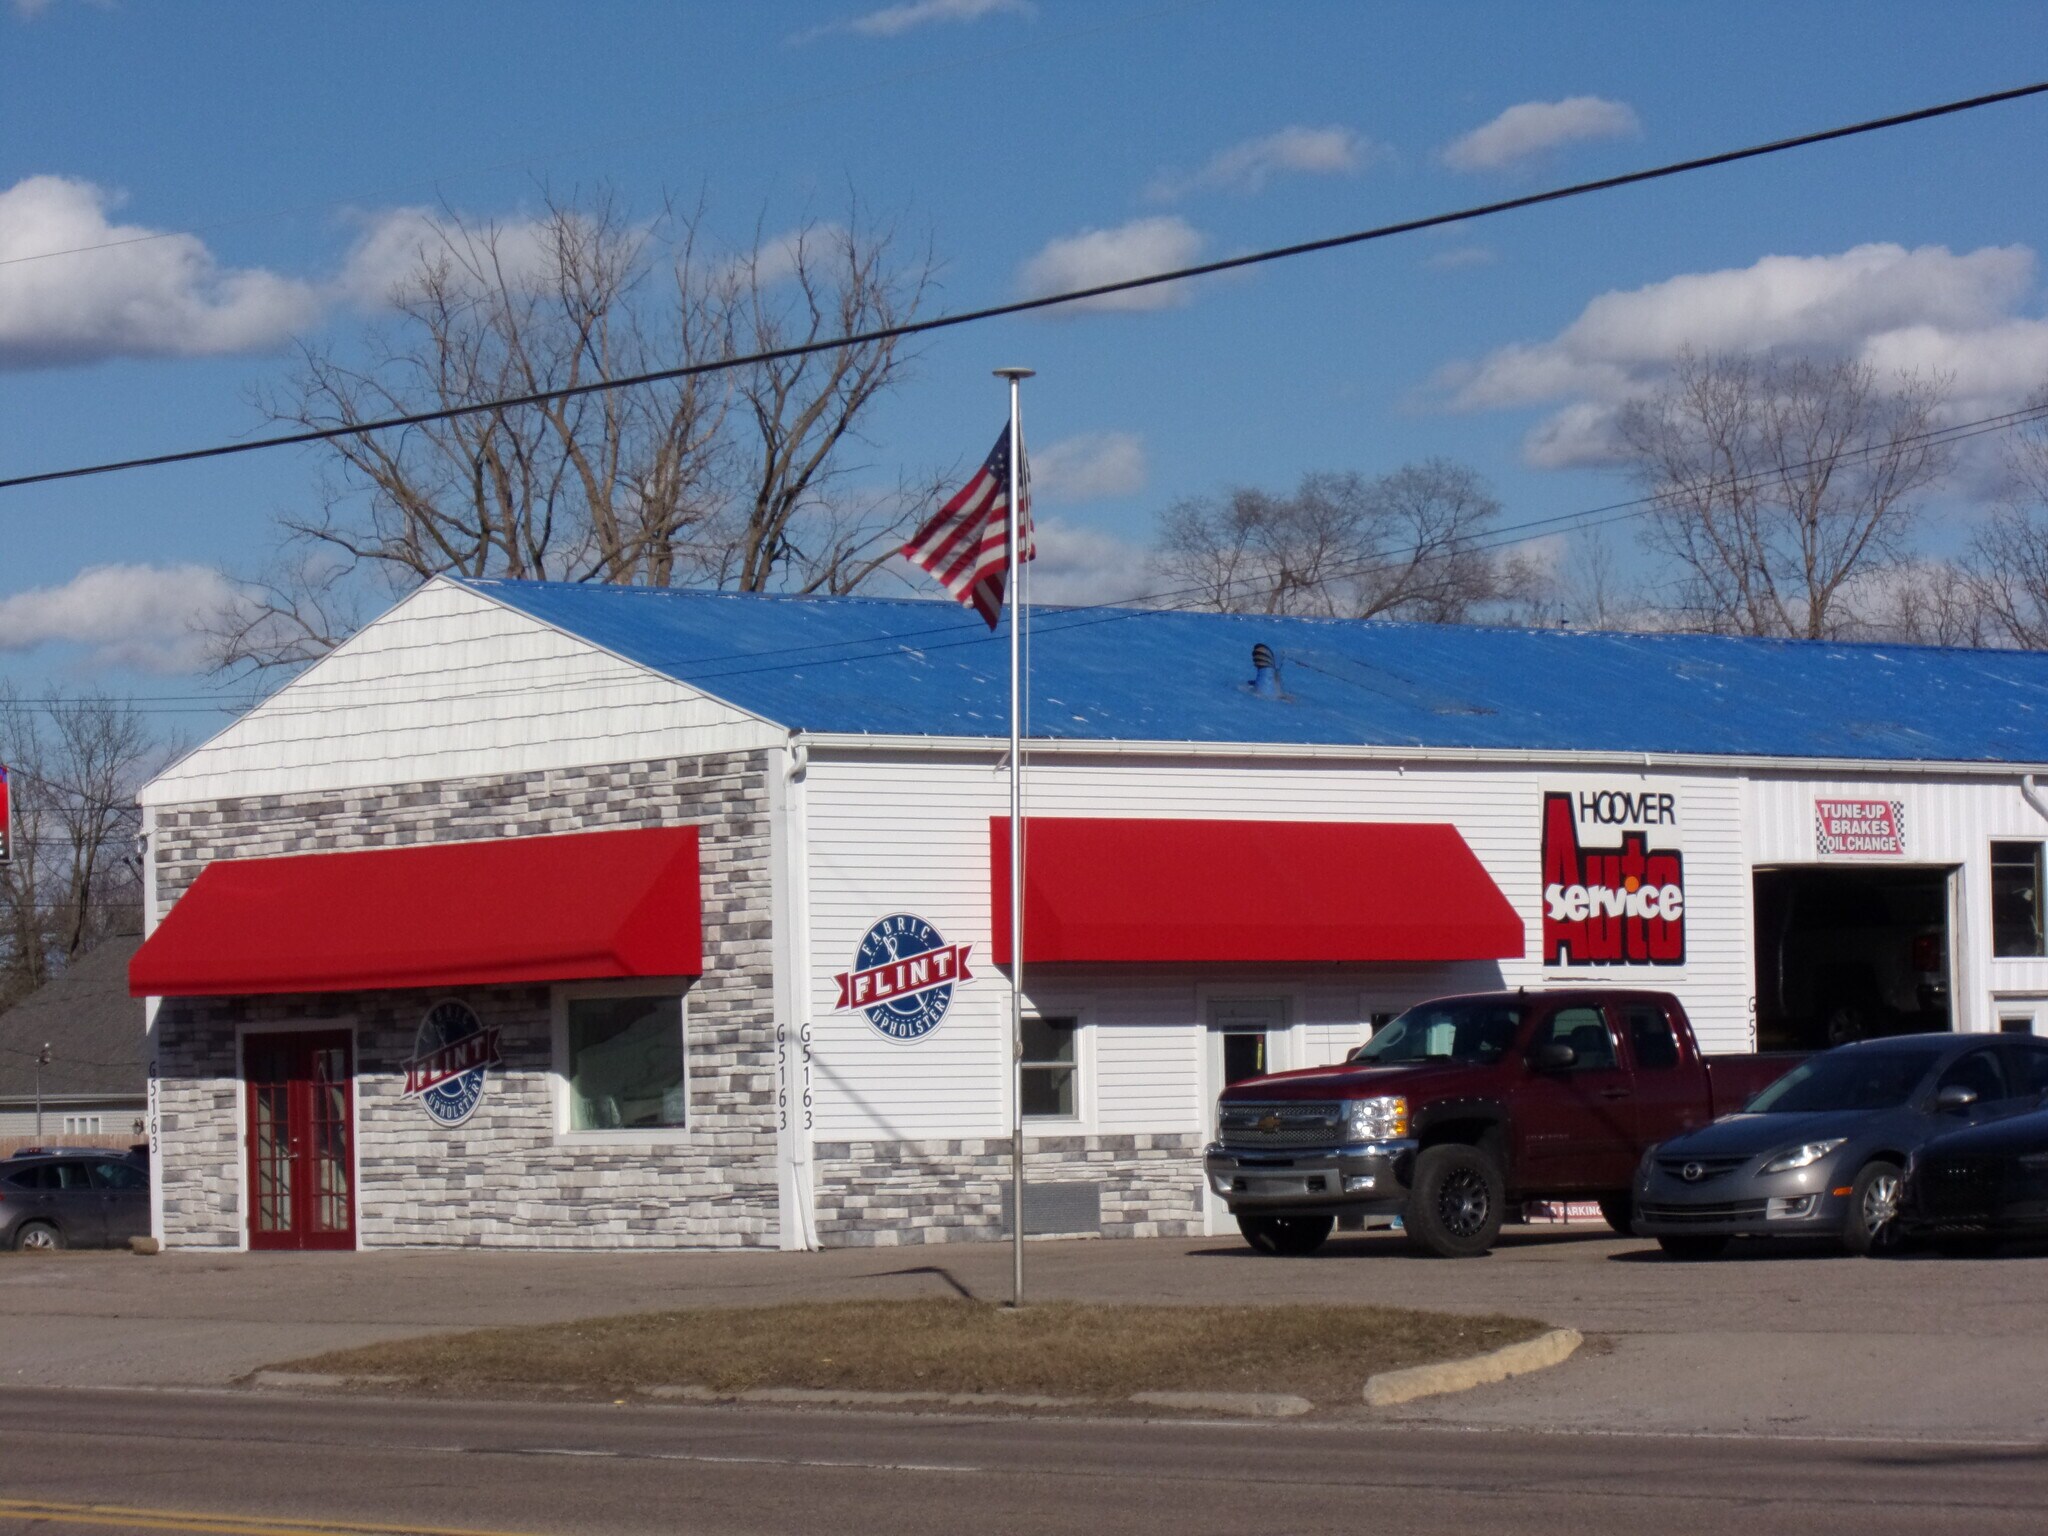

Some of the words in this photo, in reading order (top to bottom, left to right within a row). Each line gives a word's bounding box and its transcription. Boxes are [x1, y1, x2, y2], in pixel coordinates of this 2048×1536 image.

[1579, 790, 1676, 825] HOOVER
[1821, 803, 1886, 819] TUNE-UP
[1831, 820, 1890, 835] BRAKES
[1847, 836, 1897, 851] CHANGE
[1542, 790, 1686, 966] Auto
[1545, 878, 1683, 921] service
[862, 917, 931, 955] FABRIC
[855, 951, 952, 1003] FLINT
[872, 990, 950, 1037] UPHOLSTERY
[416, 1035, 484, 1088] FLINT
[777, 1023, 787, 1130] G5163
[800, 1023, 812, 1130] G5163
[149, 1061, 158, 1154] G5163
[428, 1073, 482, 1119] UPHOLSTERY
